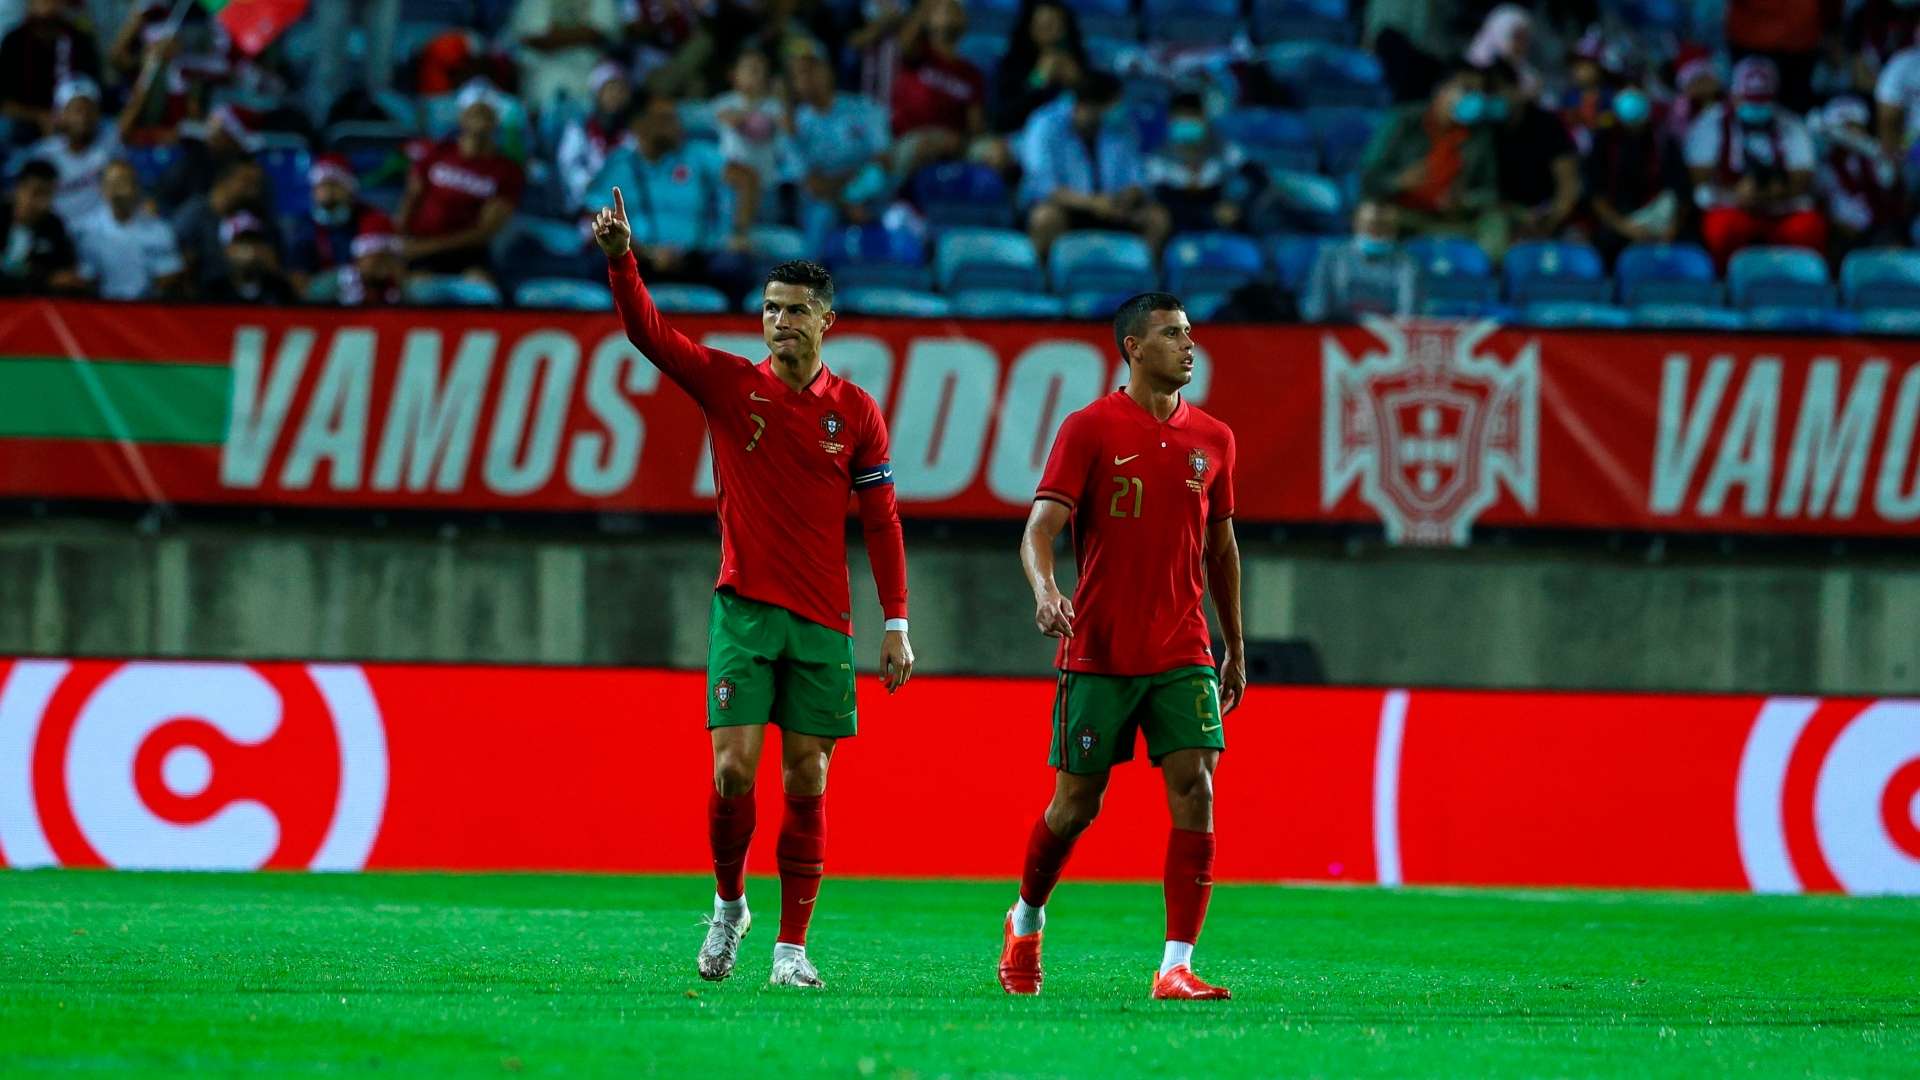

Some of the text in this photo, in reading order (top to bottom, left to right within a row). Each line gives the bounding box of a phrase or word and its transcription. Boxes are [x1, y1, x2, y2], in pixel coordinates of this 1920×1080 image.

[220, 326, 661, 497] VAMOS
[745, 413, 766, 452] 7
[1110, 476, 1143, 518] 21
